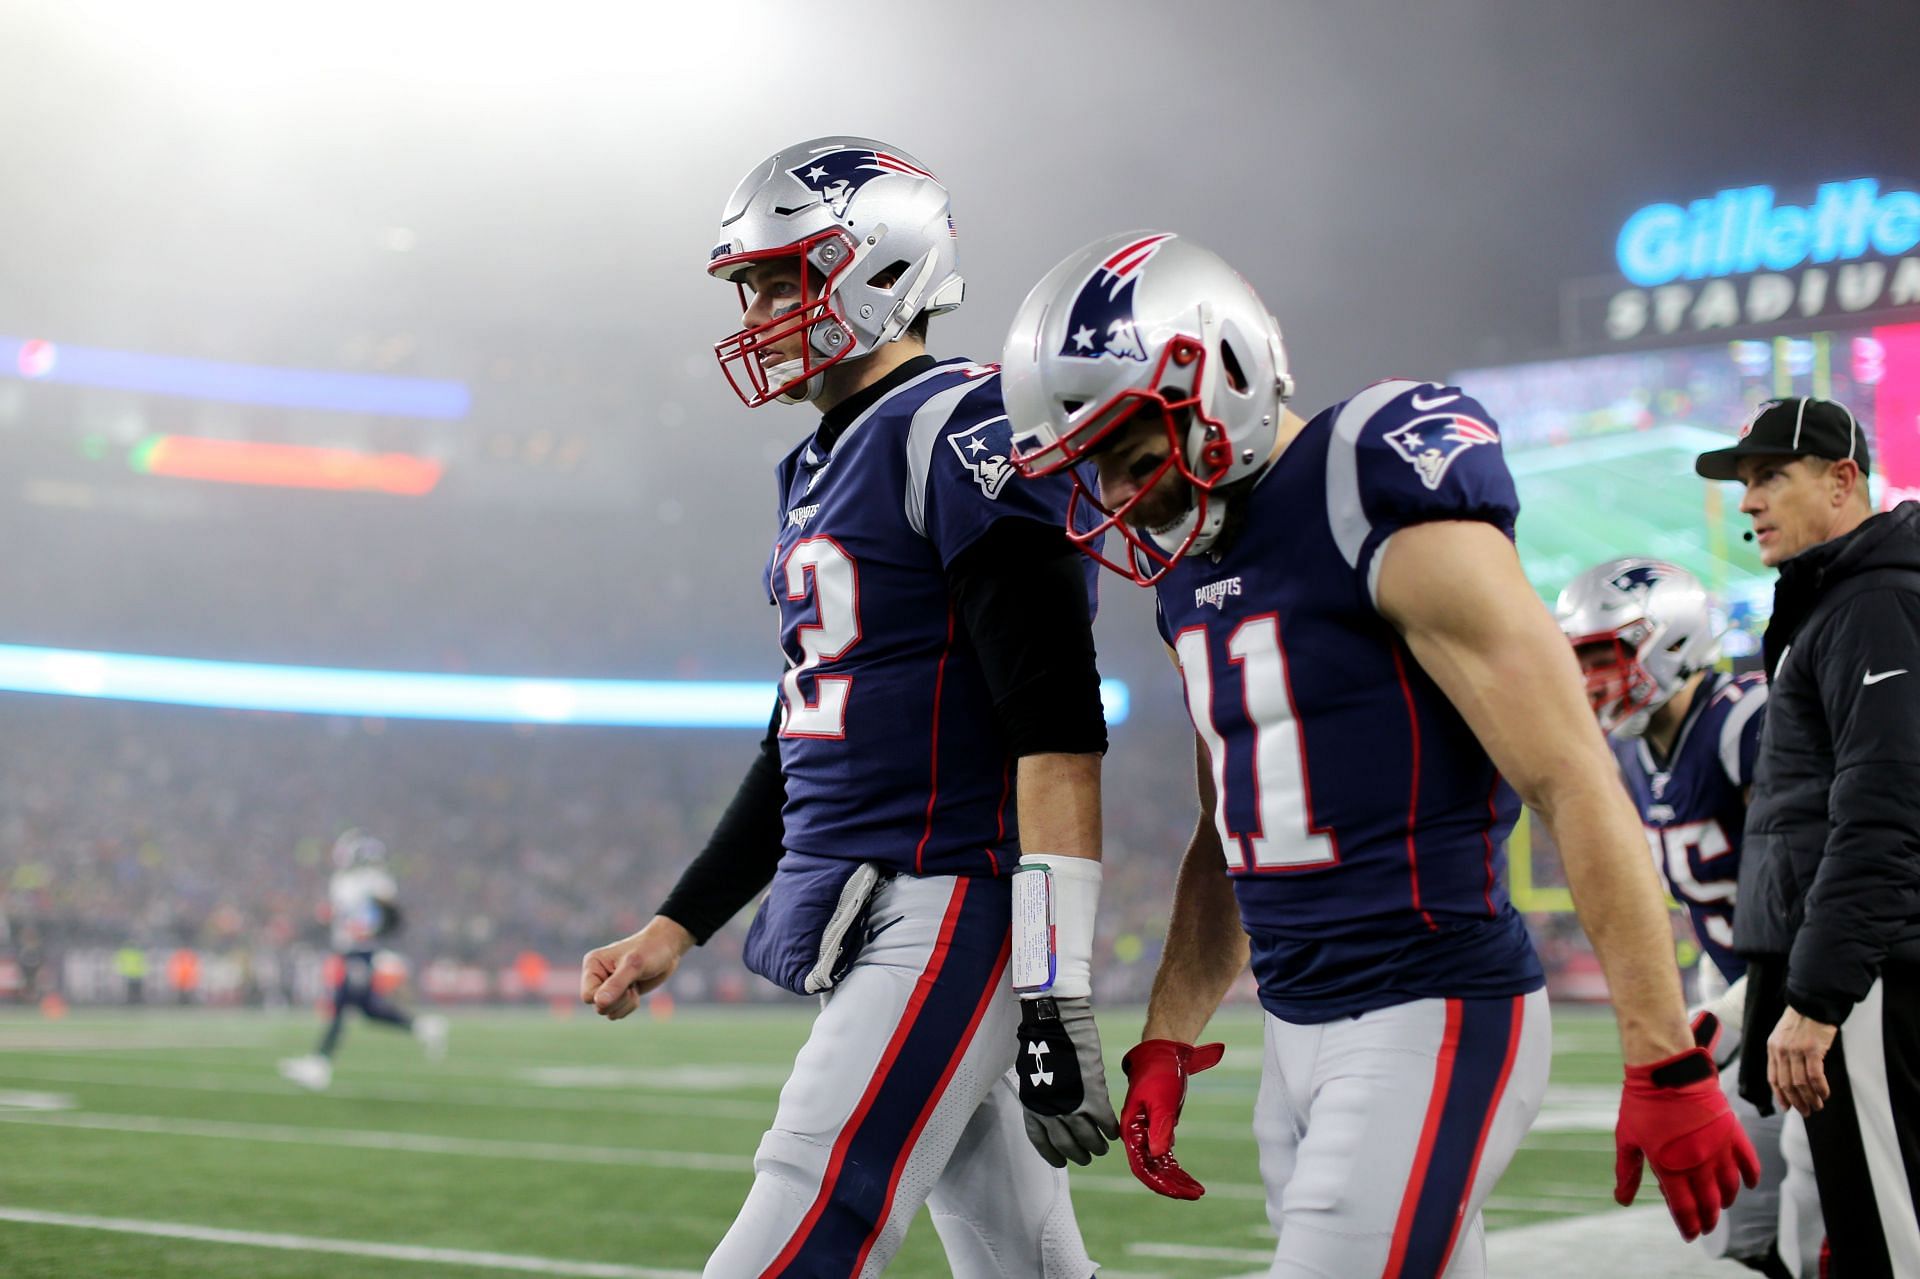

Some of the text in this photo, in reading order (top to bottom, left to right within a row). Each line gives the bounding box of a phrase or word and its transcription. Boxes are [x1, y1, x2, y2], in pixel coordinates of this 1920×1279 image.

[1617, 177, 1920, 287] Gillette
[771, 533, 863, 741] 2
[1194, 576, 1241, 609] PATRIOTS
[1175, 610, 1341, 873] 11
[1643, 817, 1738, 949] 5
